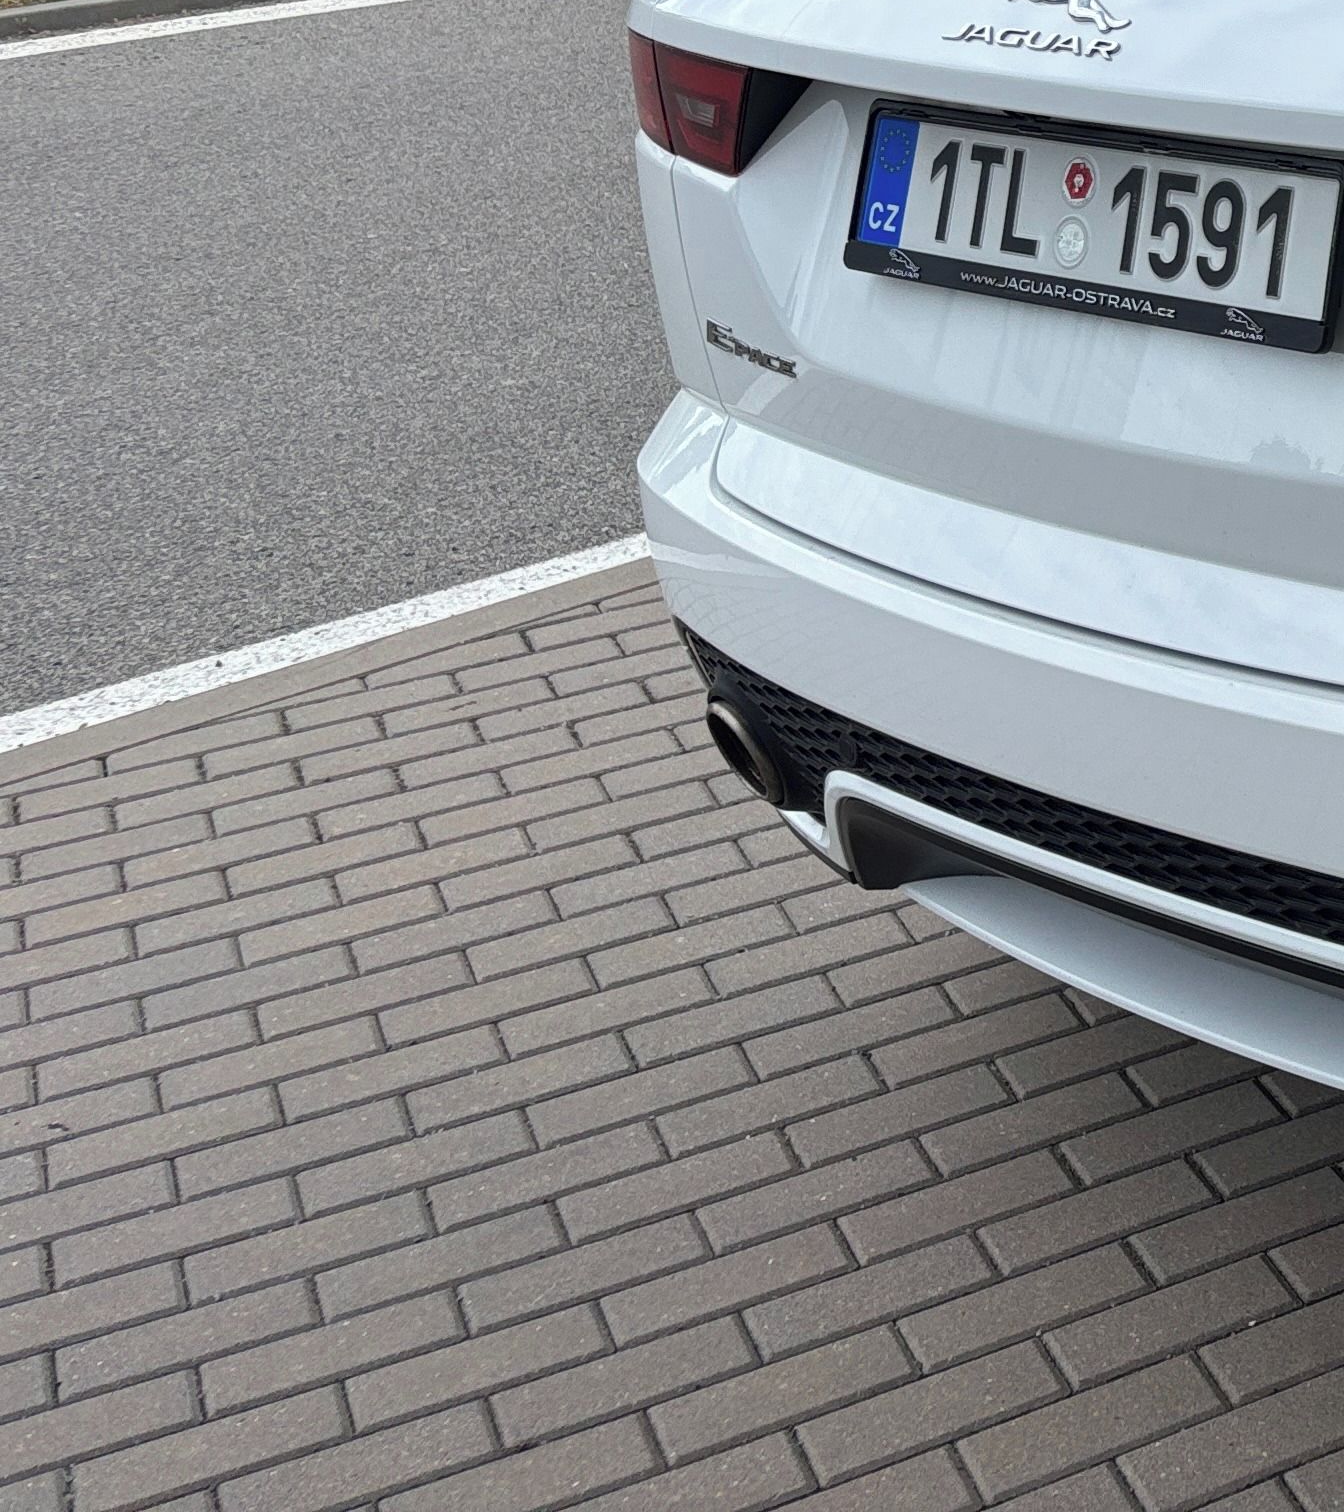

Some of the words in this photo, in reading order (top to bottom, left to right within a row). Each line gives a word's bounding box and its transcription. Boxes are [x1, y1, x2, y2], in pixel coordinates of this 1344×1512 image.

[941, 23, 1121, 62] JAGUAR
[867, 201, 898, 232] CZ
[928, 139, 1040, 257] 1TL
[1110, 165, 1296, 300] 1591
[883, 267, 920, 280] JAGUAR
[959, 271, 1176, 319] www.JAGUAR-OSTRAVA.cz
[1220, 328, 1265, 342] JAGUAR
